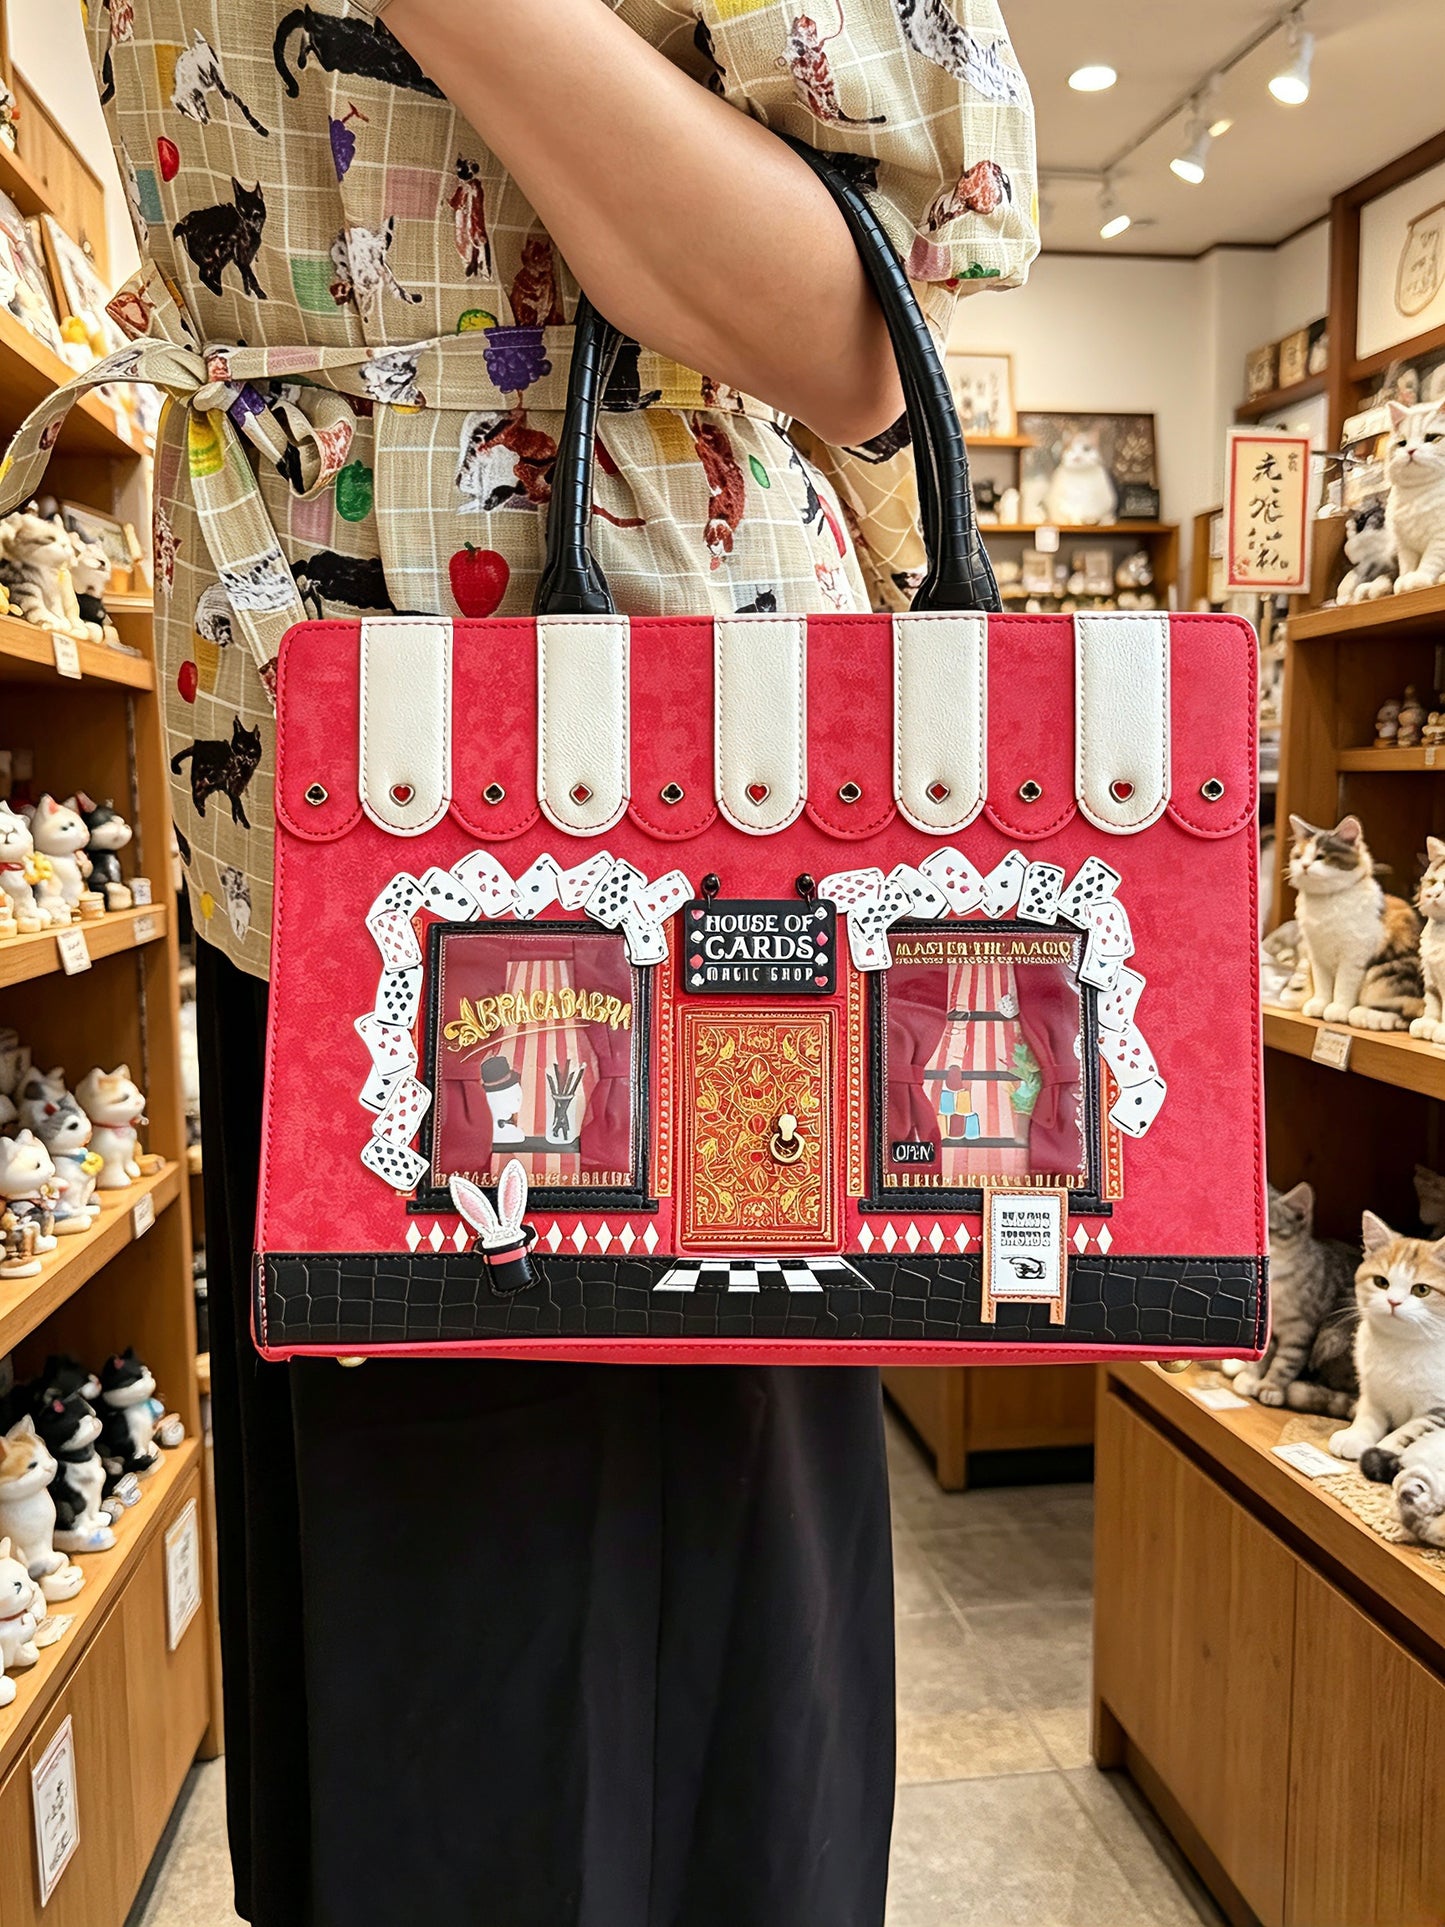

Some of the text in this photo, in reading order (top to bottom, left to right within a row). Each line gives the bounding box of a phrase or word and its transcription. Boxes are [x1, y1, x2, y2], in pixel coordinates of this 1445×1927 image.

[704, 914, 815, 933] HOUSE OF
[704, 935, 815, 960] CARDS
[706, 966, 813, 982] MAGIC SHOP
[896, 1144, 932, 1161] OPEN
